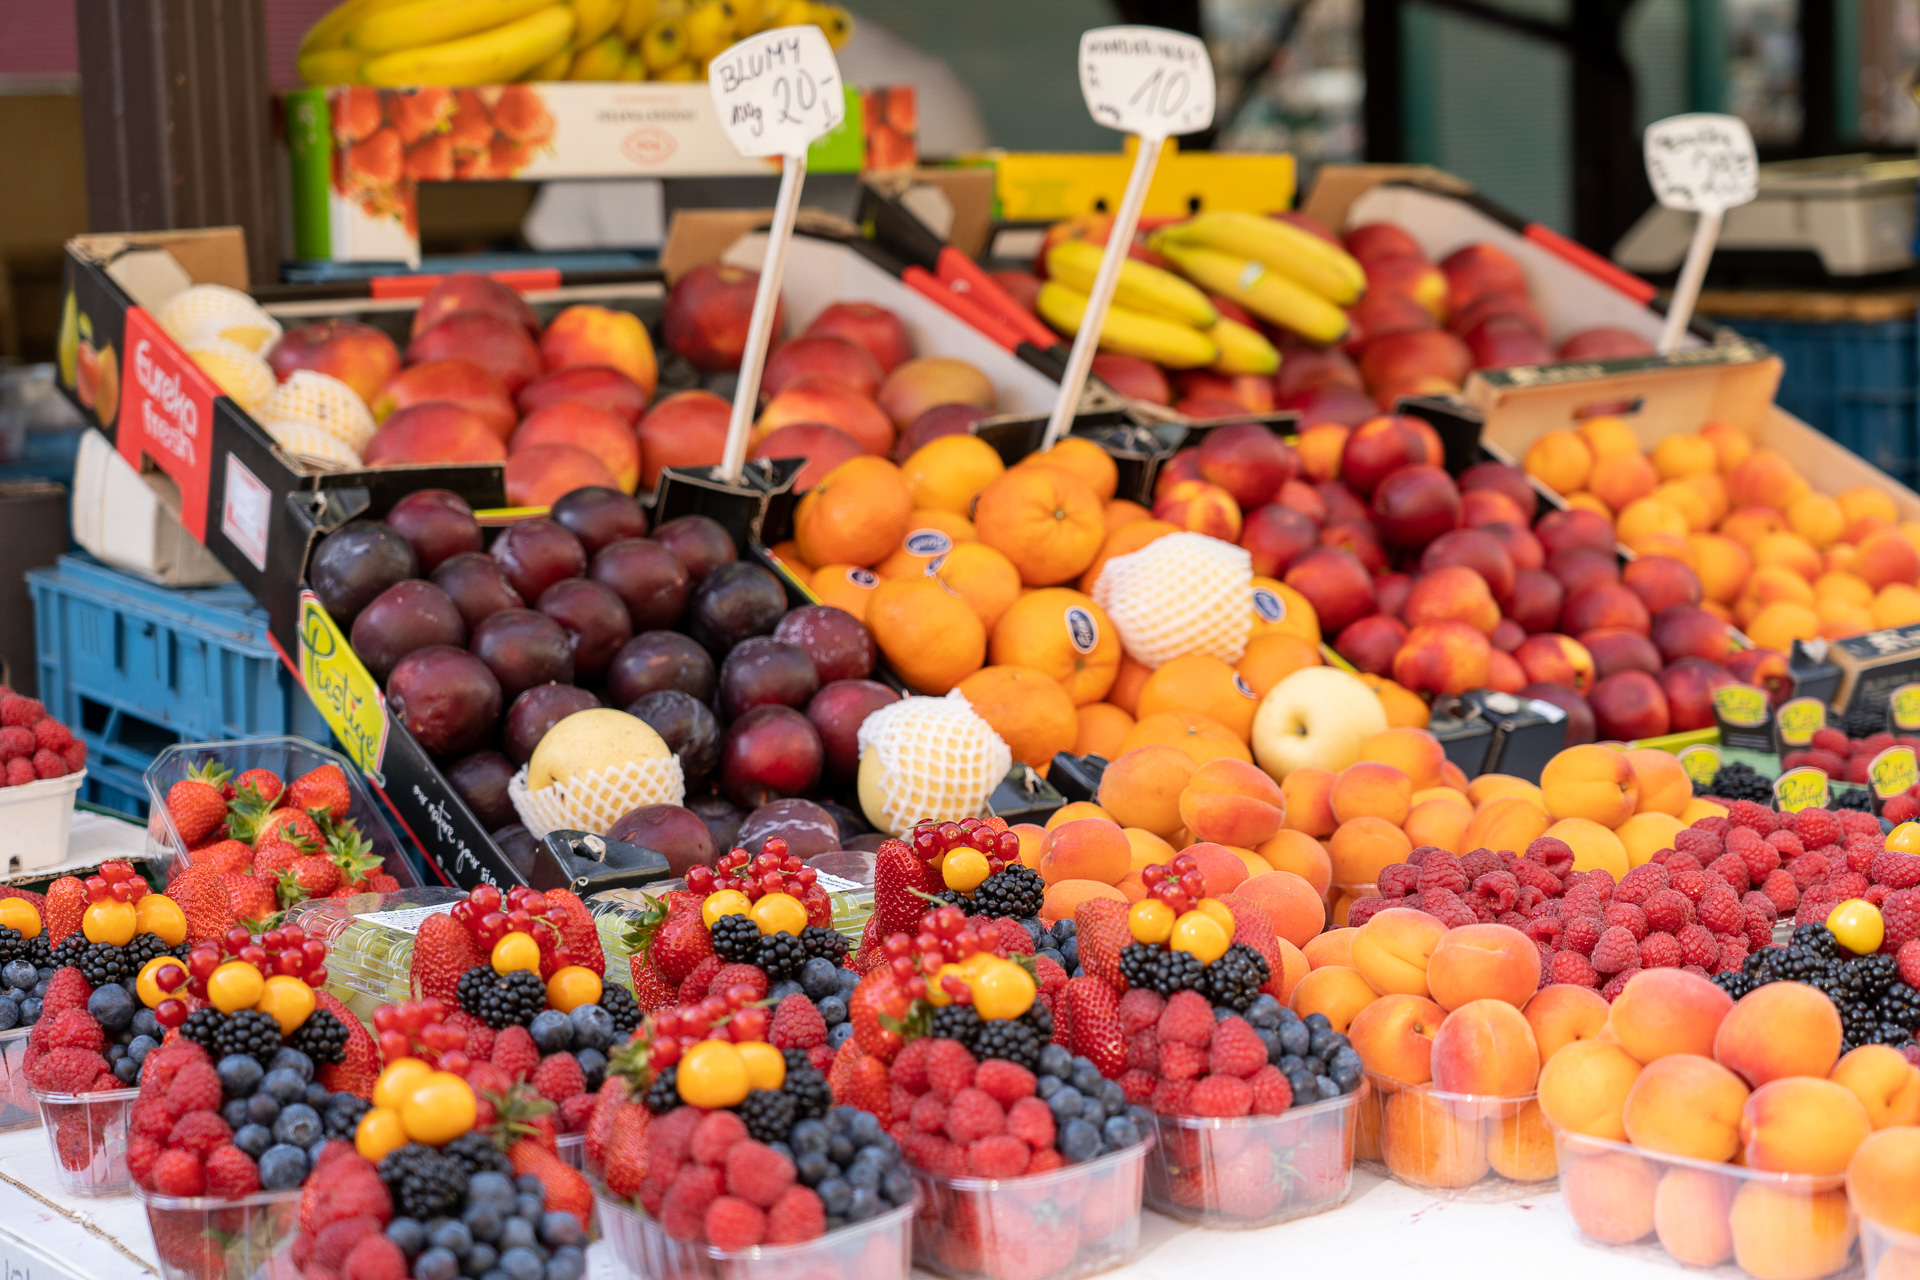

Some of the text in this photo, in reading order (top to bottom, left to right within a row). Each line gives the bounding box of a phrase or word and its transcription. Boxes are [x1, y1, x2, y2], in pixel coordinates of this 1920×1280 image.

[719, 37, 800, 94] BLUMY
[134, 339, 198, 439] Eureka
[142, 398, 197, 467] fresh
[296, 606, 385, 785] Prestige
[428, 799, 456, 844] nature
[1776, 778, 1829, 808] Prestige
